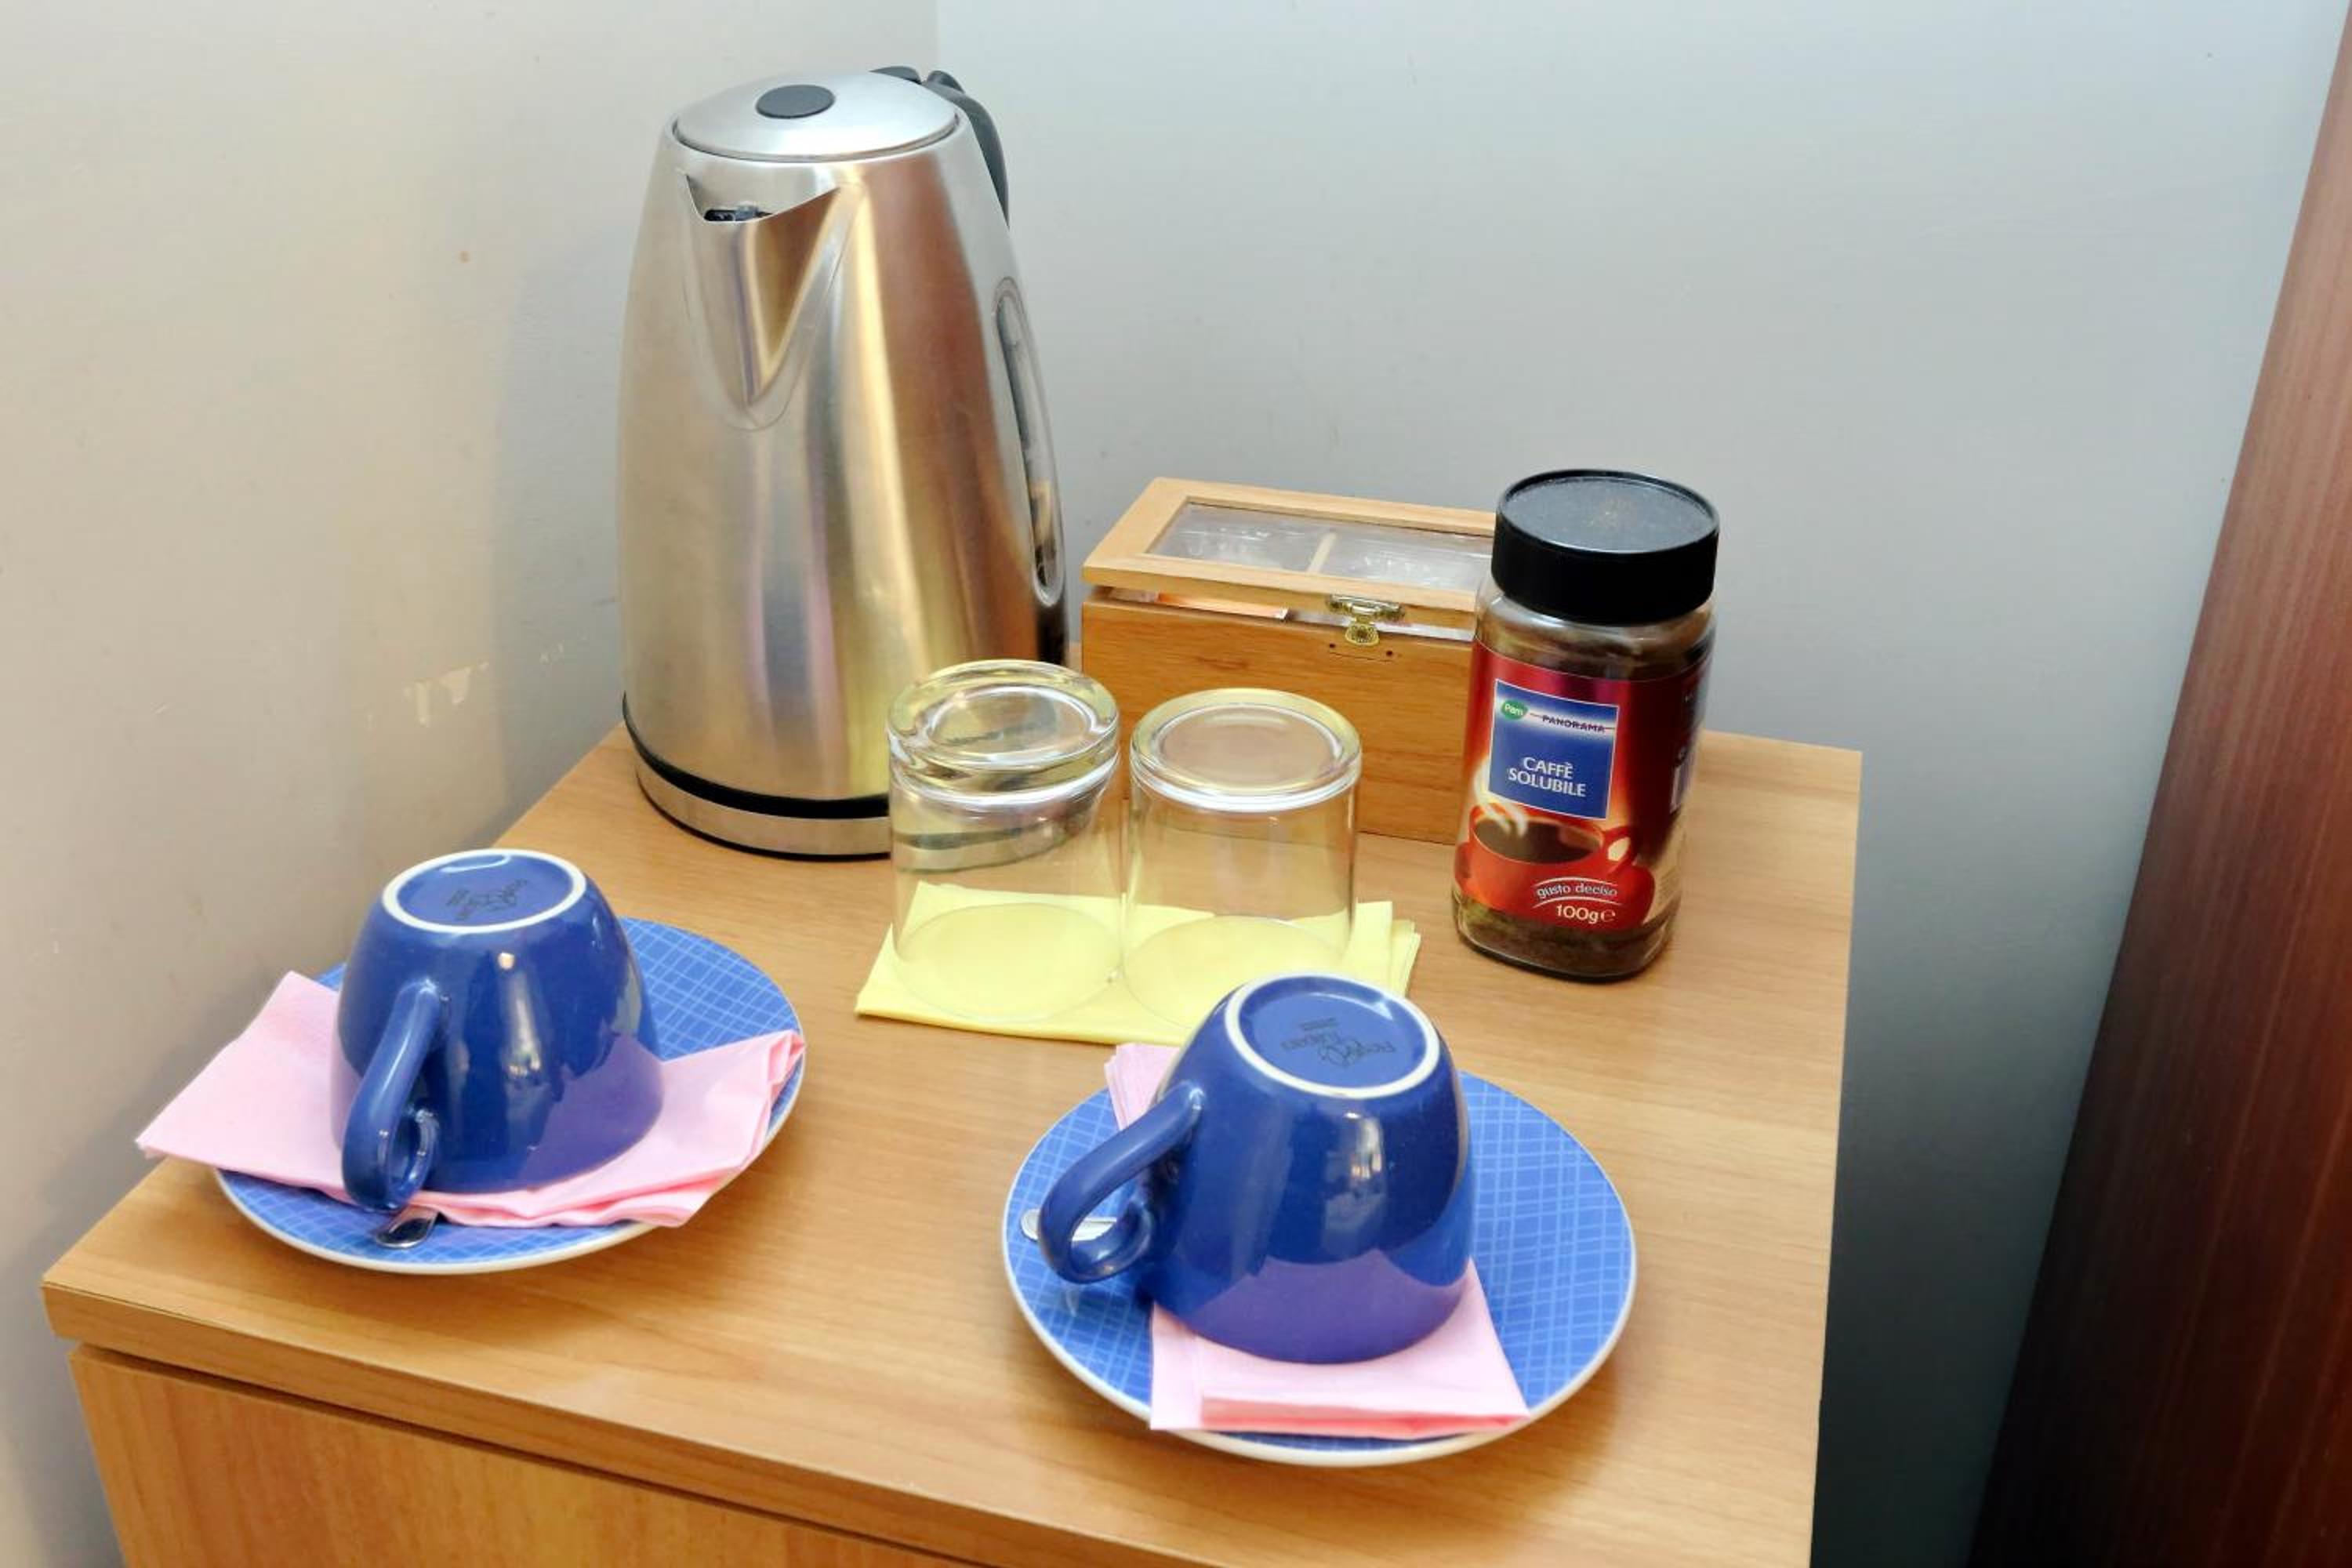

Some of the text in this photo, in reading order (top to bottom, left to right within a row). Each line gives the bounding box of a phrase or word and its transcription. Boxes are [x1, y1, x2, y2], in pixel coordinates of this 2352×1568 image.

[1542, 714, 1606, 733] PANORAMA
[1523, 757, 1573, 780] CAFFÈ
[1508, 768, 1586, 797] SOLUBILE
[1537, 883, 1617, 899] gusto deciso
